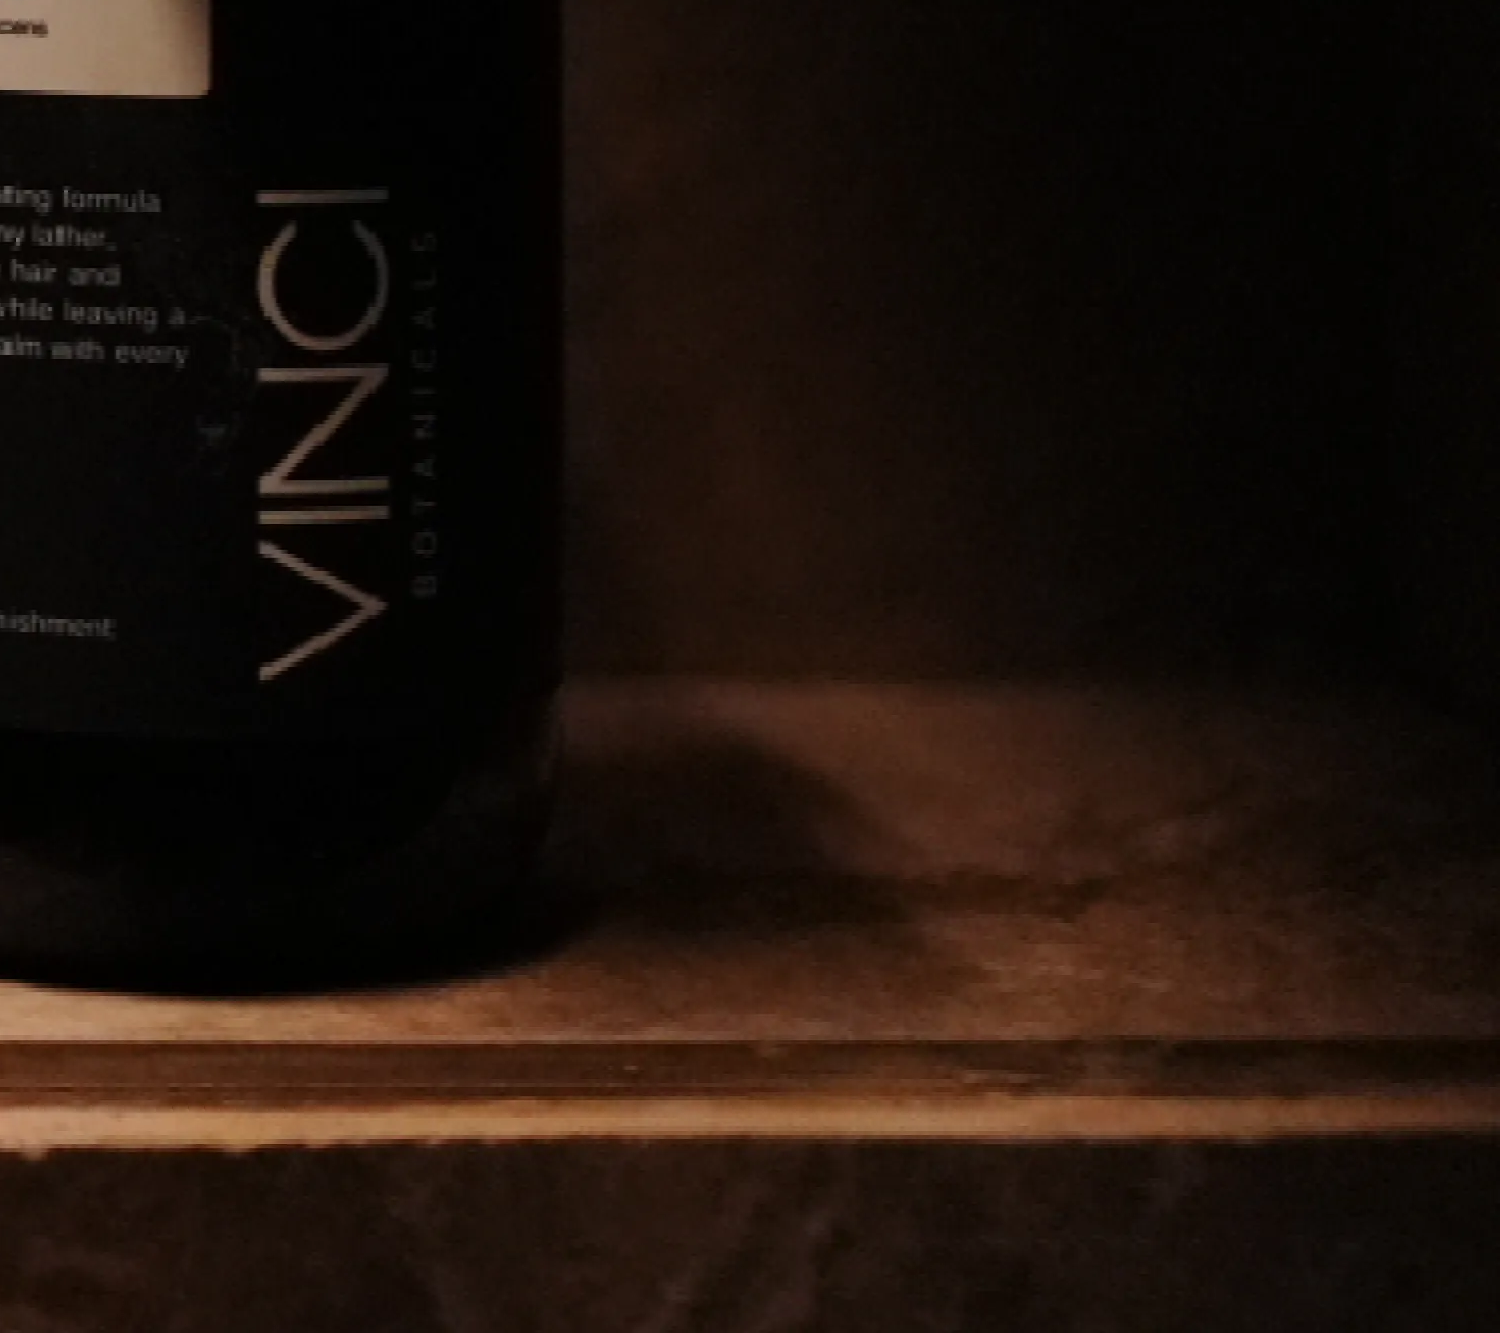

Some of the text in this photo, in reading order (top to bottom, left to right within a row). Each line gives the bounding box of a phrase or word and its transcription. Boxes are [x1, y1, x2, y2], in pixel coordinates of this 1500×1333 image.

[62, 185, 163, 214] formula
[9, 258, 57, 283] hair
[66, 263, 122, 288] and
[62, 302, 159, 332] leaving
[50, 336, 105, 363] with
[114, 341, 190, 373] every
[411, 230, 440, 599] BOTANICALS
[256, 188, 390, 683] VINCI
